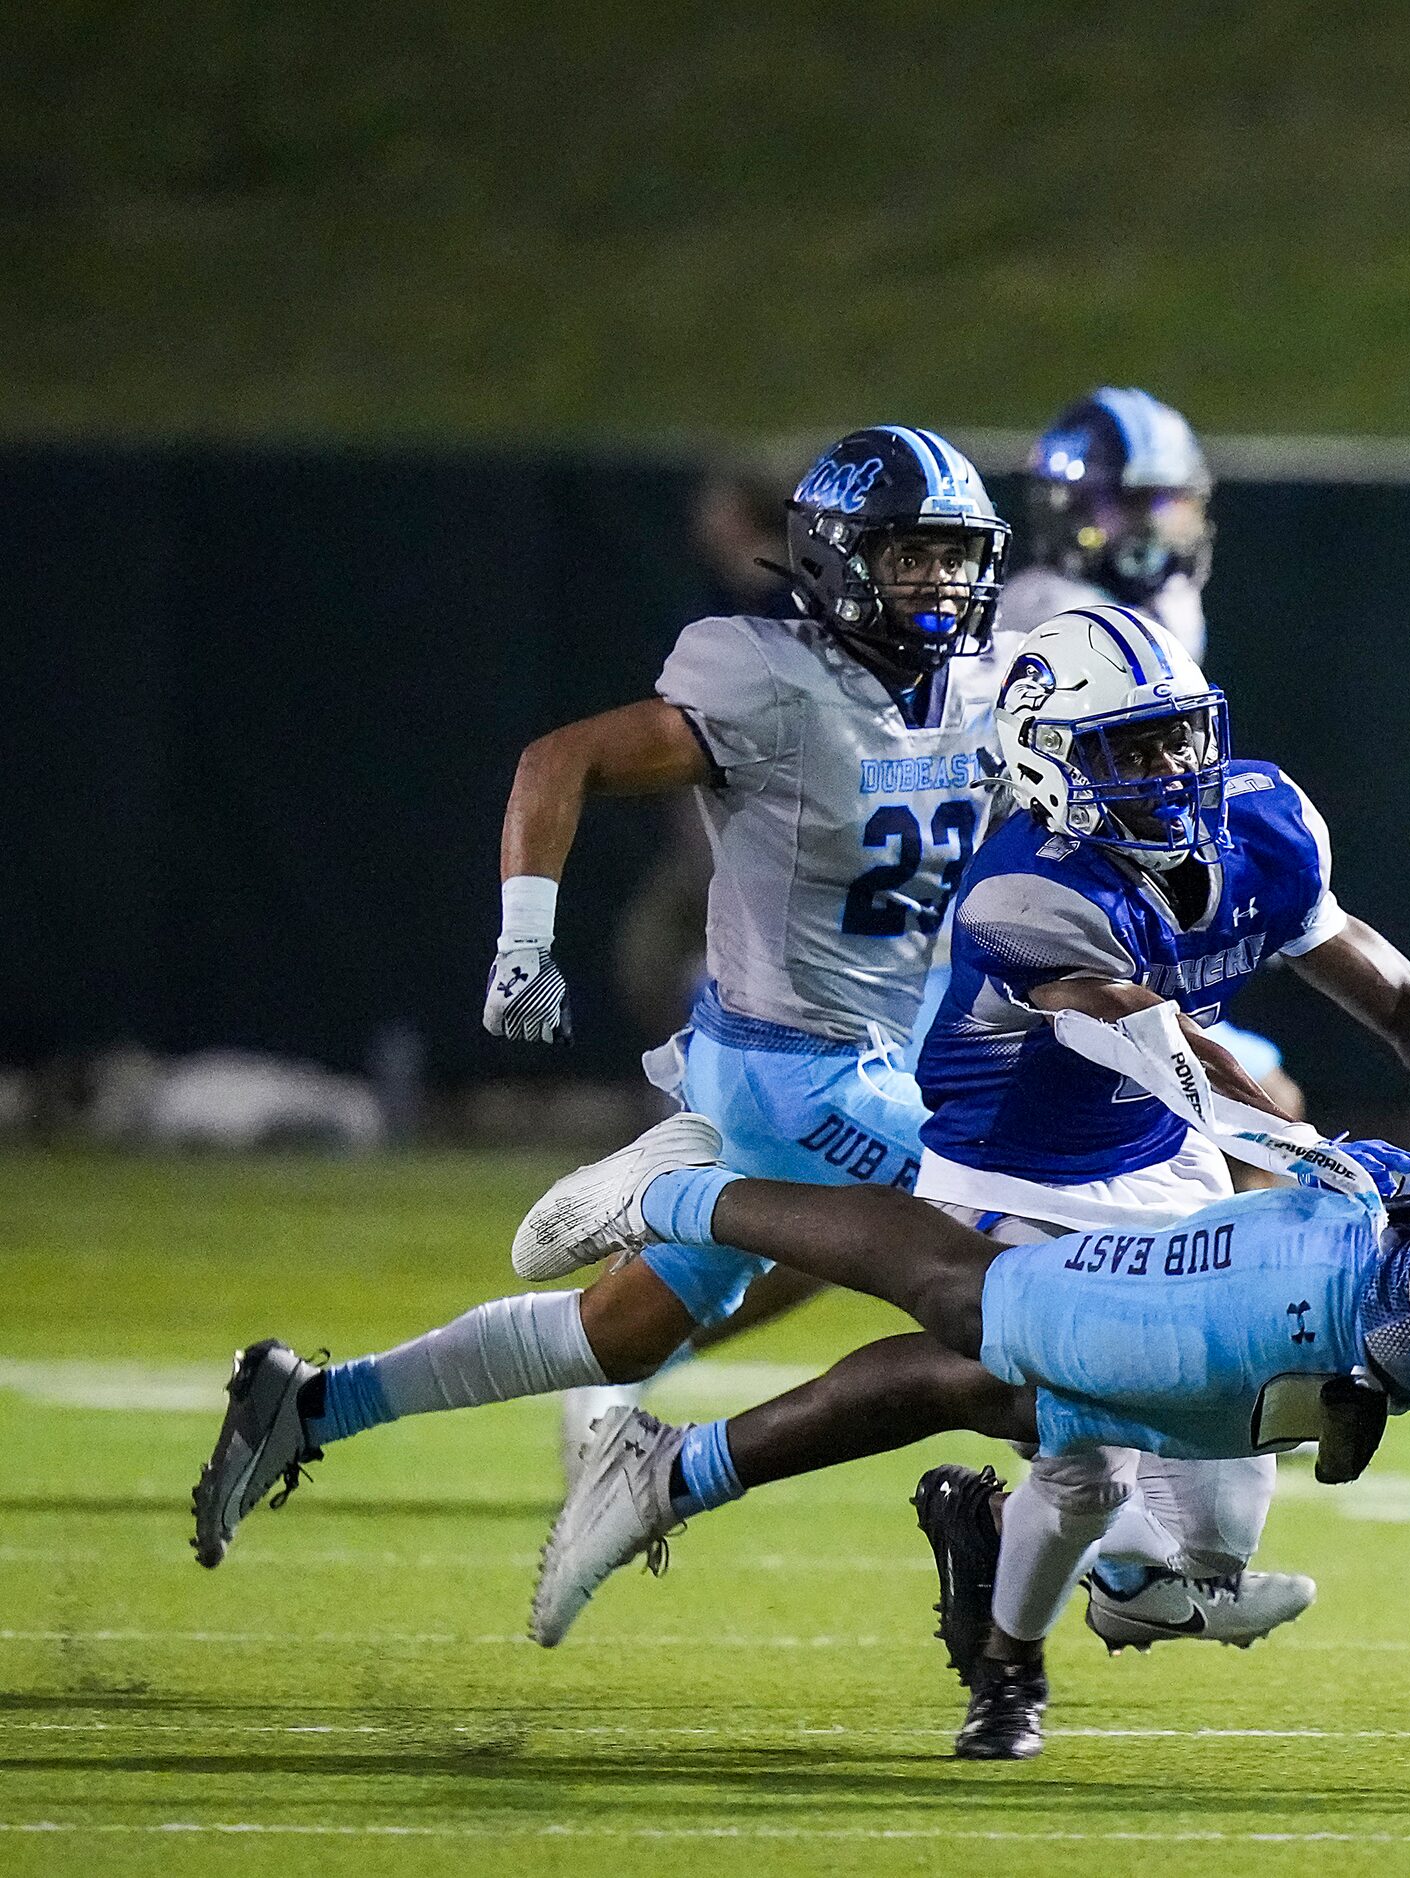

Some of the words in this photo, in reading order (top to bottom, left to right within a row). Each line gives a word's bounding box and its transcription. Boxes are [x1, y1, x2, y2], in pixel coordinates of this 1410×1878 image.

[797, 1112, 888, 1181] DUB
[1064, 1235, 1155, 1275] EAST
[1164, 1223, 1235, 1276] DUB
